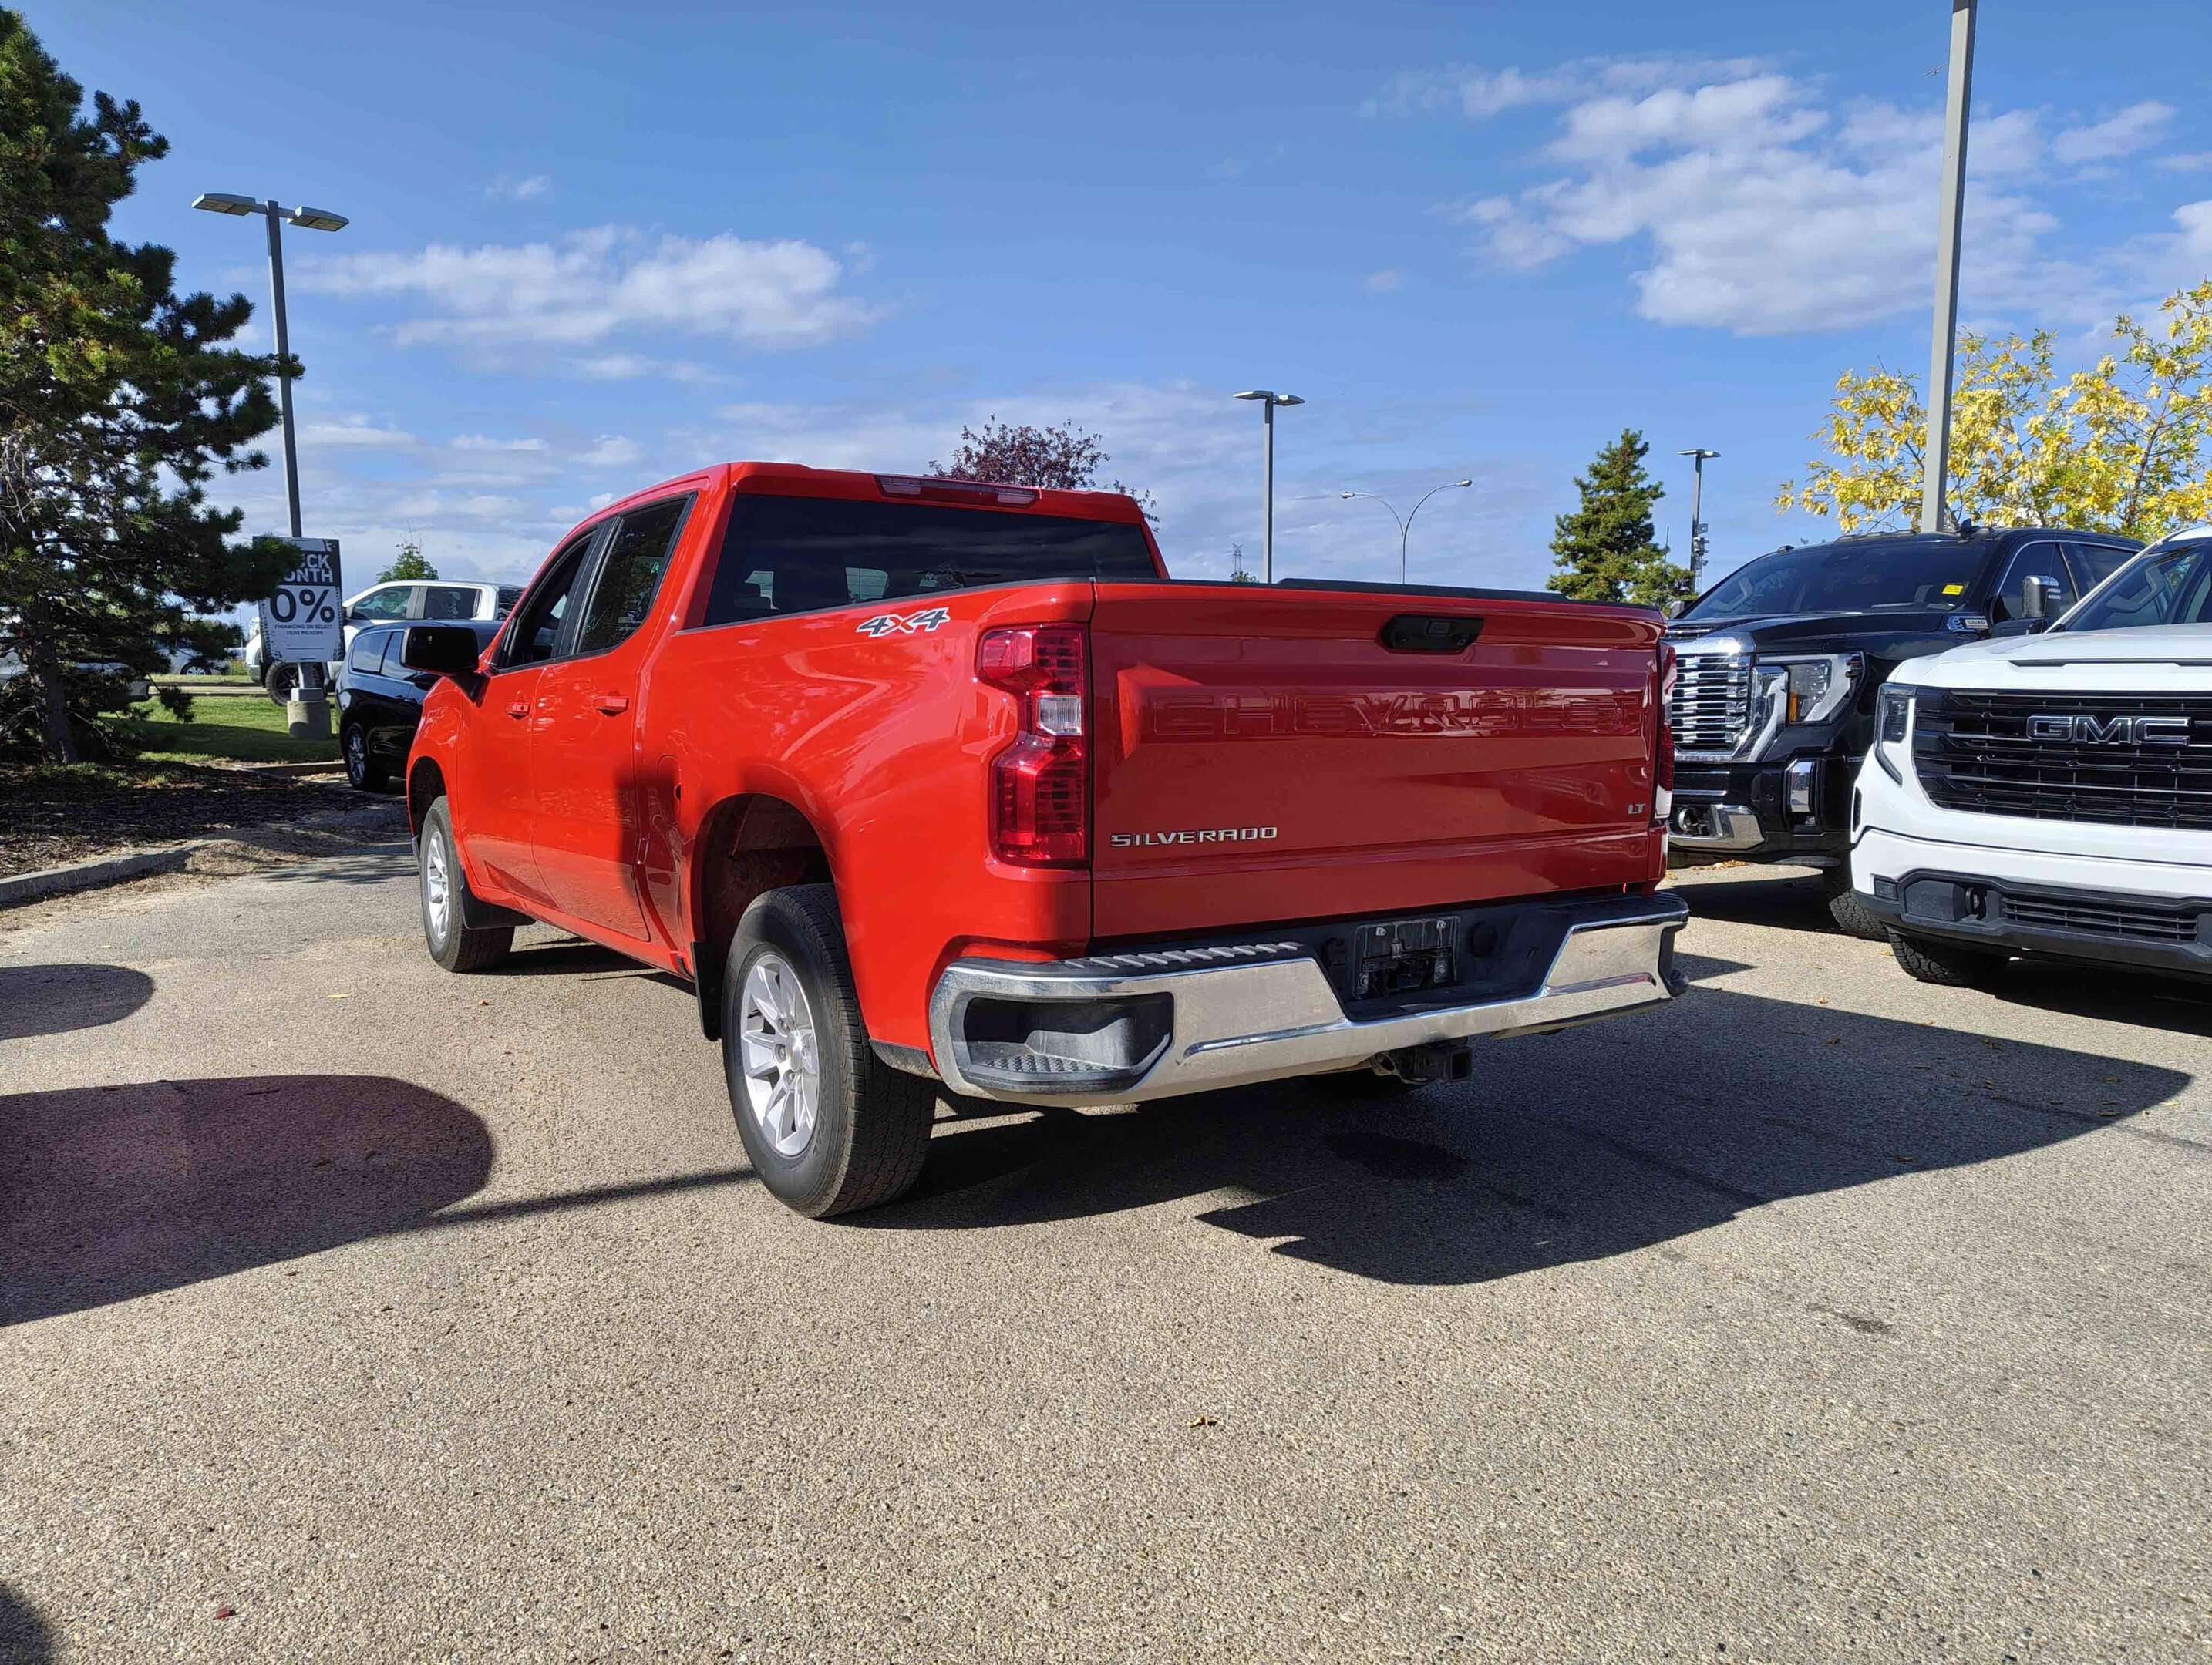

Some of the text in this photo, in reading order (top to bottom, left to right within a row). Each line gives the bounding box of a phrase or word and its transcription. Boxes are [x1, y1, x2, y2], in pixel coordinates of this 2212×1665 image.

[282, 567, 334, 583] ONTH
[270, 588, 335, 624] 0%
[1149, 691, 1642, 735] CHEVROLET
[2026, 714, 2192, 746] GMC
[1628, 803, 1646, 815] LT
[1110, 826, 1278, 847] SILVERADO
